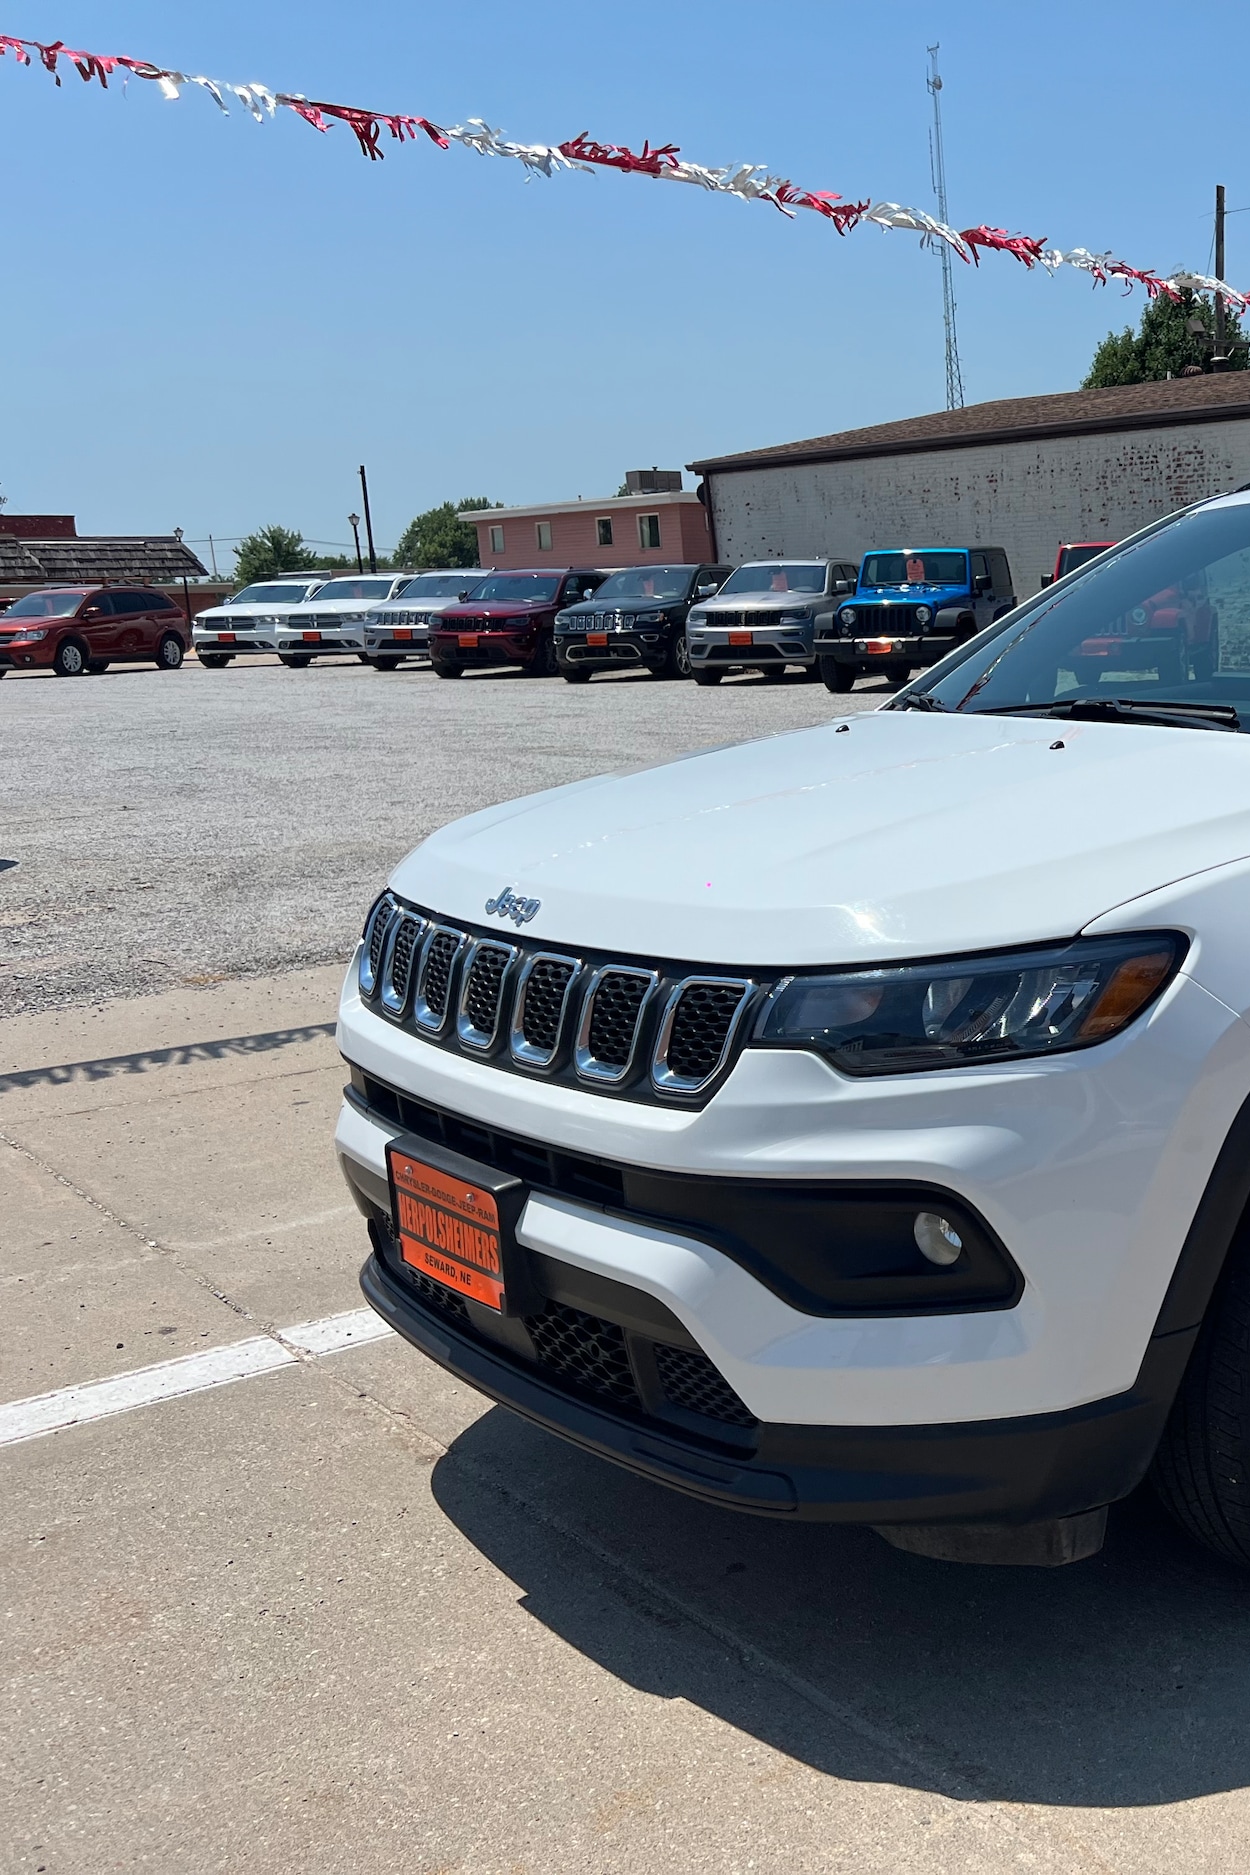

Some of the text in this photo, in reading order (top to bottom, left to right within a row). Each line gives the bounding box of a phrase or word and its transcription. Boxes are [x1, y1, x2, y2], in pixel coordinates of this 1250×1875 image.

[485, 887, 541, 927] Jeep
[424, 1252, 472, 1286] SEWARD, NE
